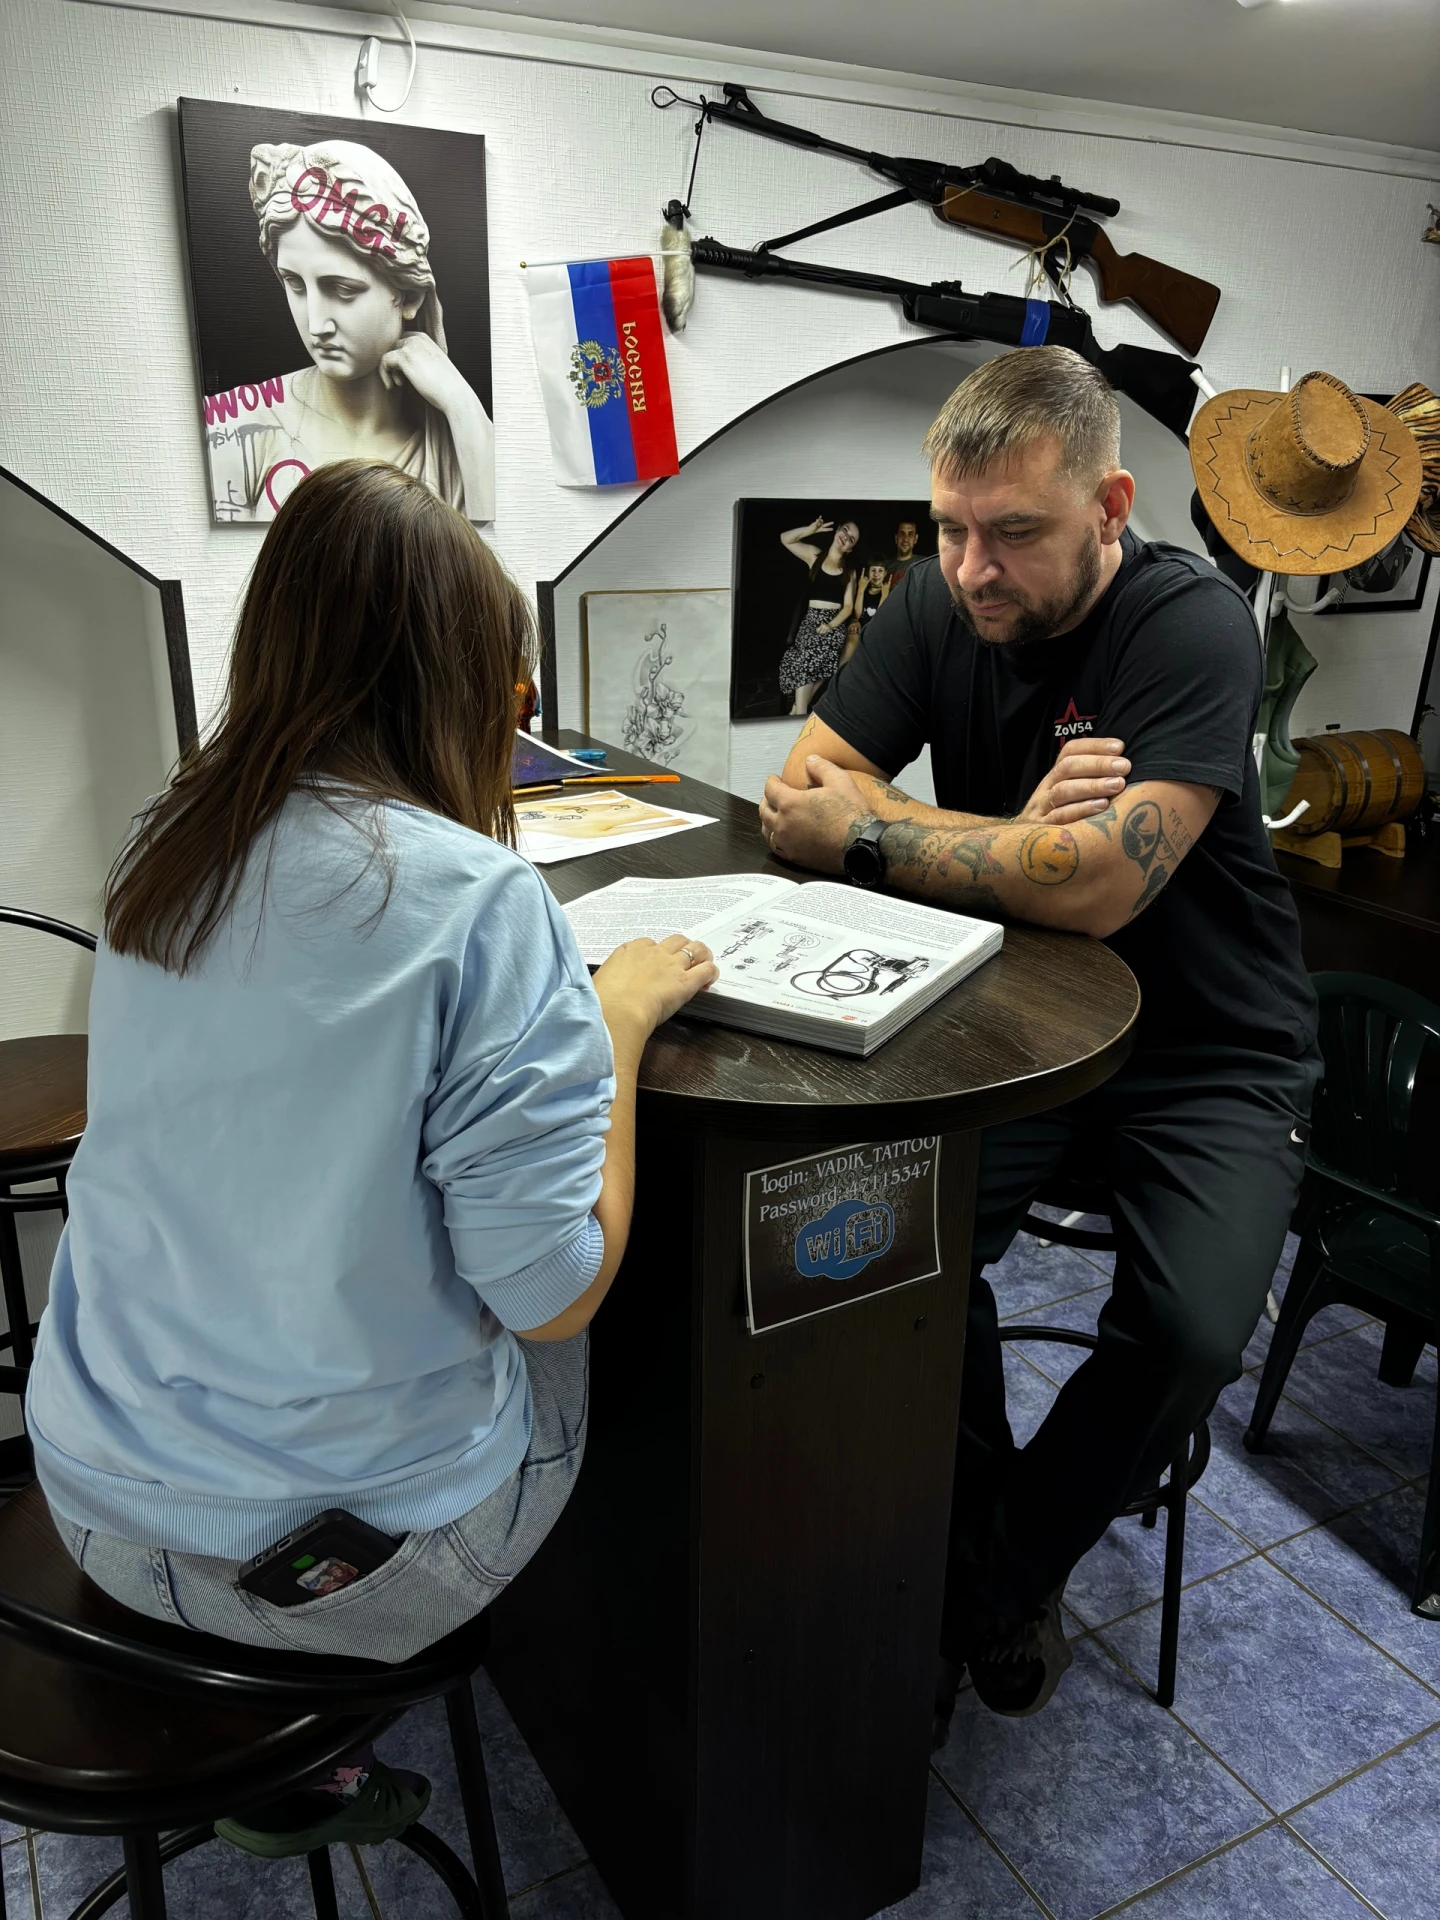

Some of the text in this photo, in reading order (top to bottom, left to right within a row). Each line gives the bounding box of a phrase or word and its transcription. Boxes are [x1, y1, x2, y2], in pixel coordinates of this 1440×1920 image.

[291, 166, 408, 260] OMG!
[759, 1160, 931, 1222] Password: 47115347
